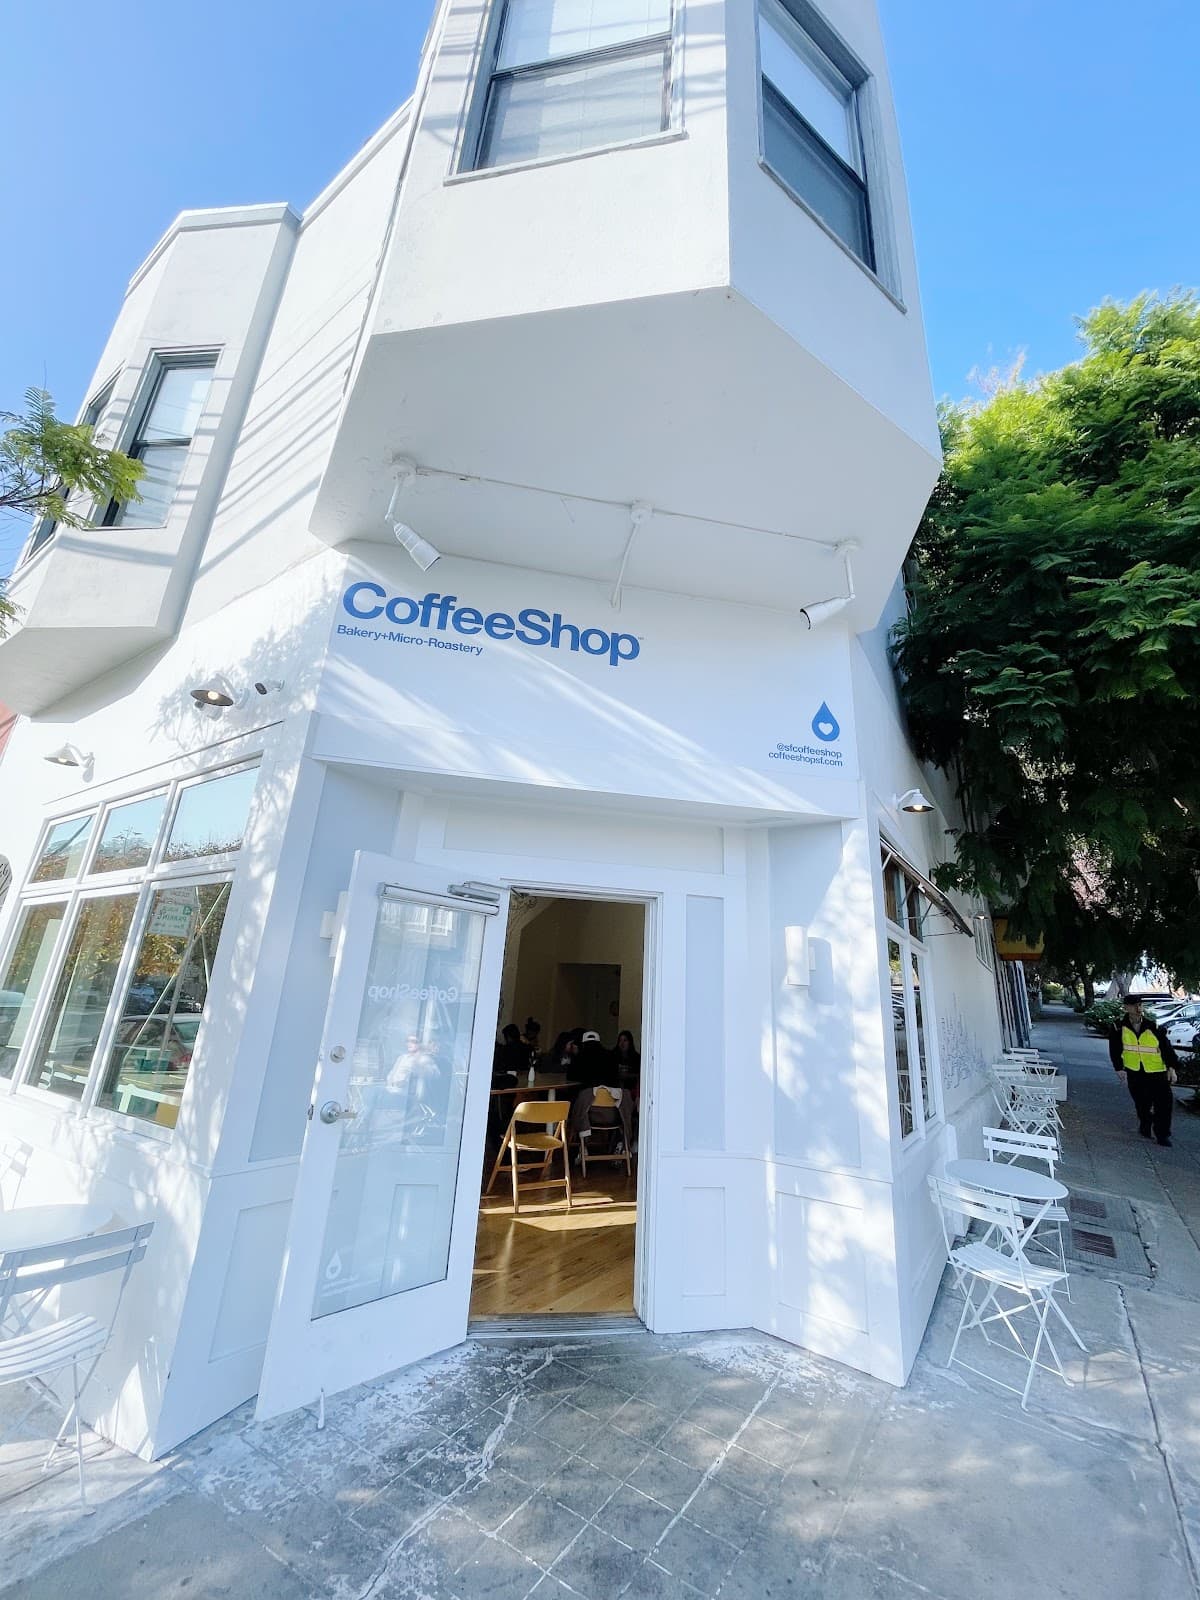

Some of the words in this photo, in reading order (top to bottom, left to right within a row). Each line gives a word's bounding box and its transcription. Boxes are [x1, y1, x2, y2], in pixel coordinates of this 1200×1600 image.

[342, 581, 641, 667] CoffeeShop
[336, 624, 484, 657] Bakery+Micro-Roastery
[768, 751, 843, 767] coffeeshopsf.com
[776, 743, 842, 759] @sfcoffeeshop
